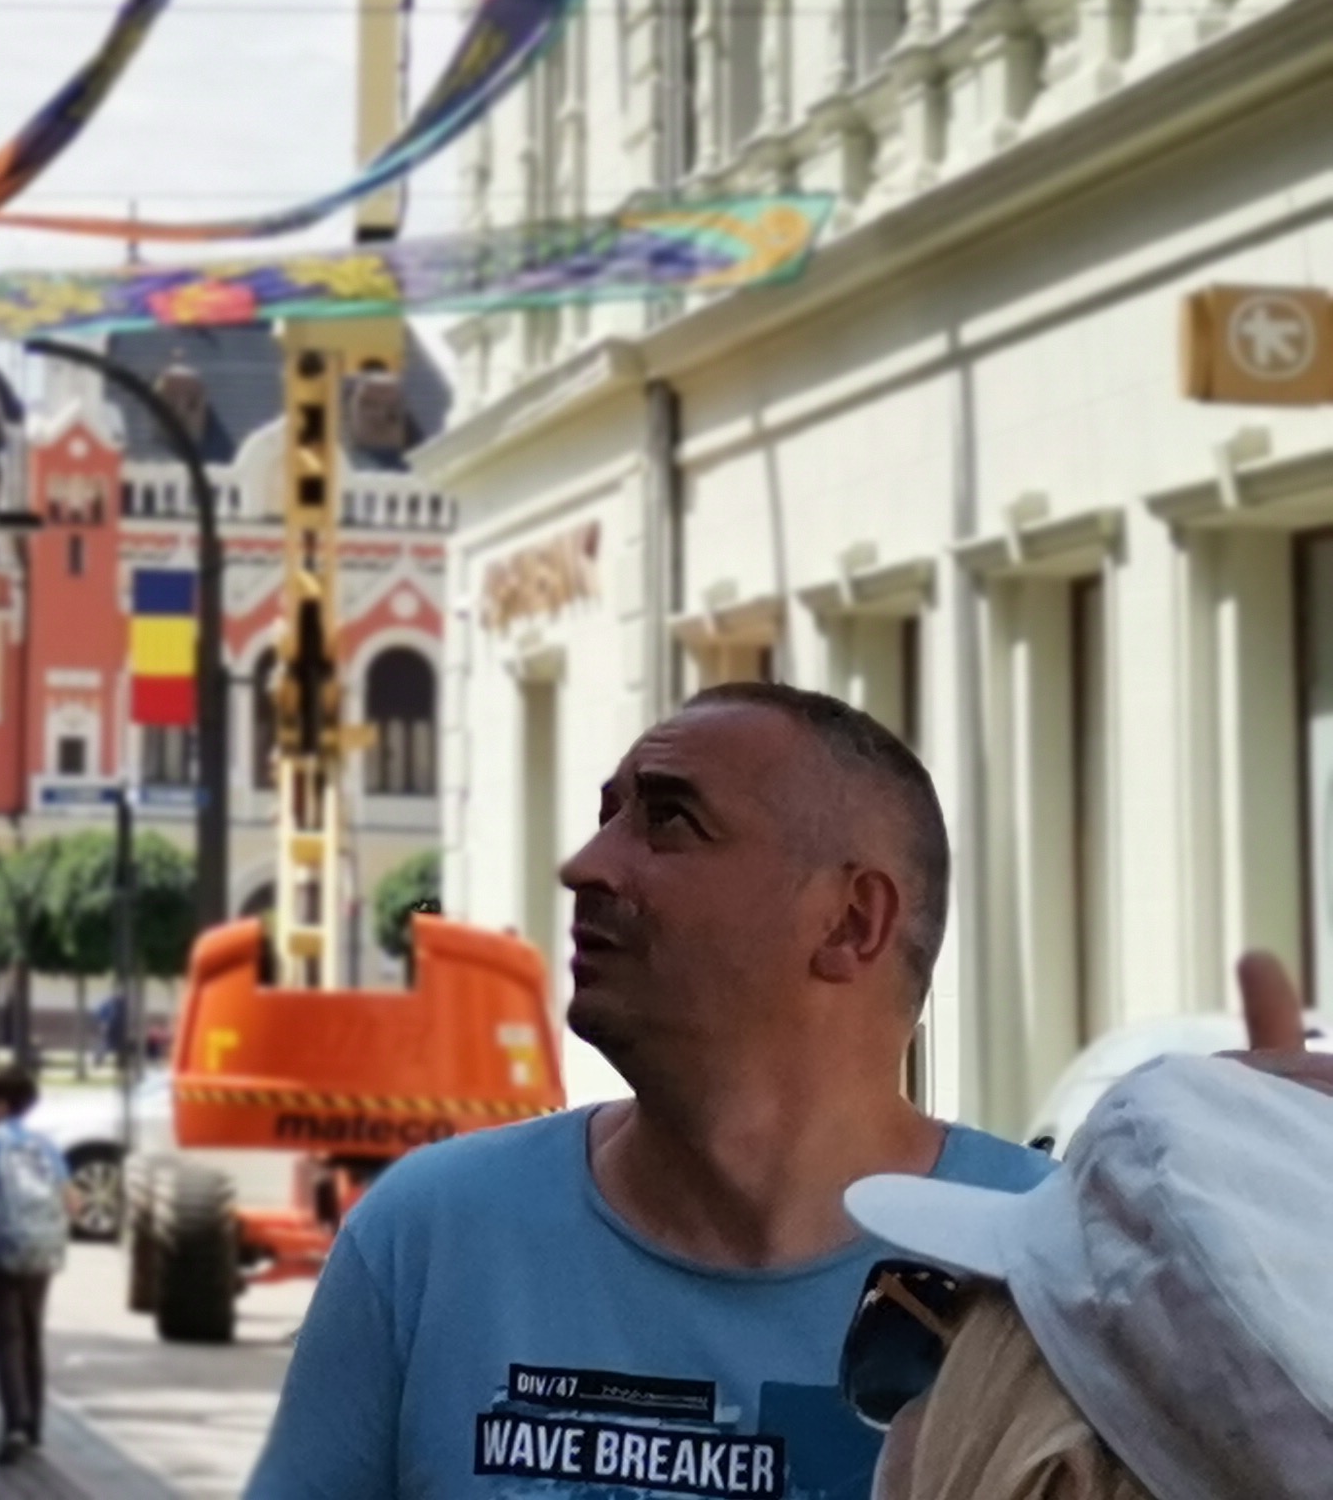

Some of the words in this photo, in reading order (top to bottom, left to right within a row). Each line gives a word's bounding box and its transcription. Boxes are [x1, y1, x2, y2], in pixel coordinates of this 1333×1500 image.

[276, 1112, 455, 1147] mateco
[483, 1419, 585, 1475] WAVE
[594, 1429, 775, 1493] BREAKER
